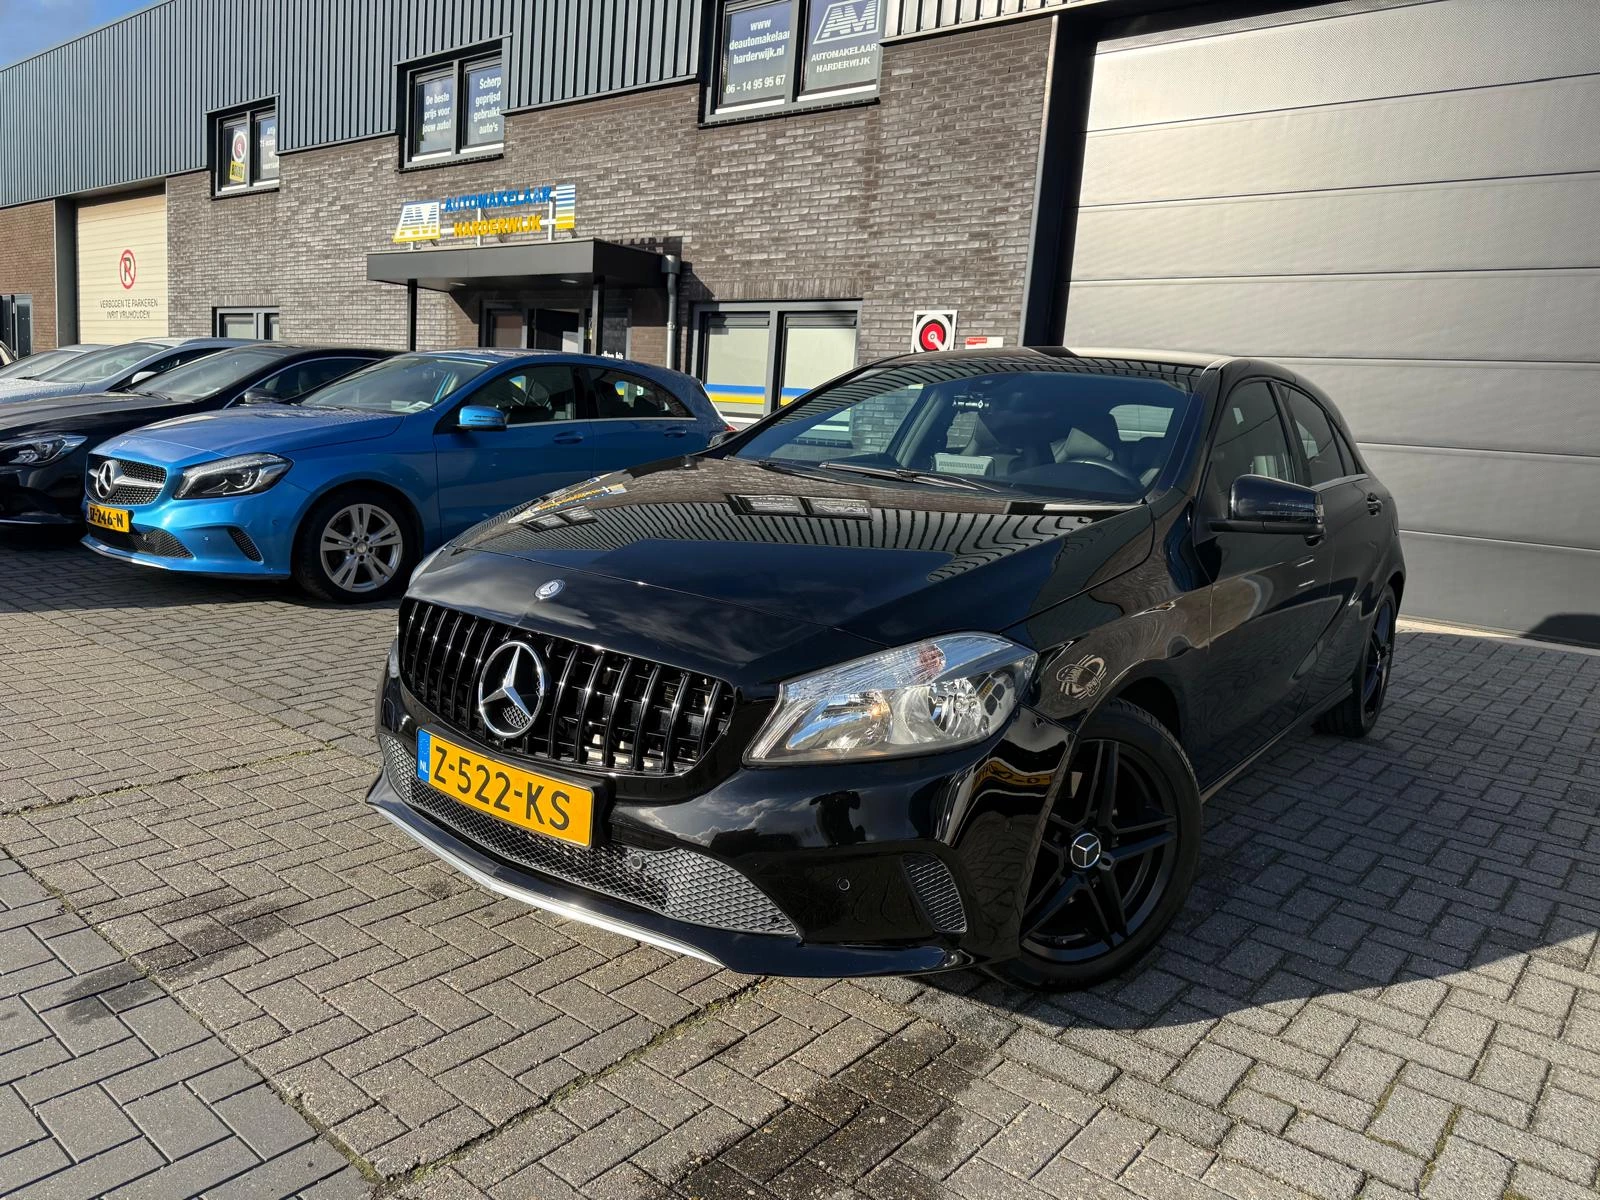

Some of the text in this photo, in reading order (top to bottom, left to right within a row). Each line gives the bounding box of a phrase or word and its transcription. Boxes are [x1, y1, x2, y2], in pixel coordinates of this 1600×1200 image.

[750, 19, 772, 31] www
[733, 45, 785, 65] harderwijk.nl
[810, 43, 877, 62] AUTOMAKELAAR
[816, 56, 871, 73] HARDERWIJK
[479, 76, 502, 90] Scherp
[726, 83, 736, 94] 06
[742, 80, 752, 91] 14
[752, 78, 763, 90] 95
[764, 76, 775, 88] 95
[775, 74, 786, 86] 67
[425, 92, 450, 105] De beste
[424, 107, 450, 121] prijs voor
[479, 122, 499, 134] auto's
[443, 185, 553, 213] AUTOMAKELAAR
[453, 215, 543, 238] HARDERWIJK
[99, 298, 159, 309] VERBODEN TE PARKEREN
[106, 309, 151, 319] INRIT VRIJHOUDEN
[419, 761, 429, 774] NL
[434, 745, 570, 831] Z-522-KS
